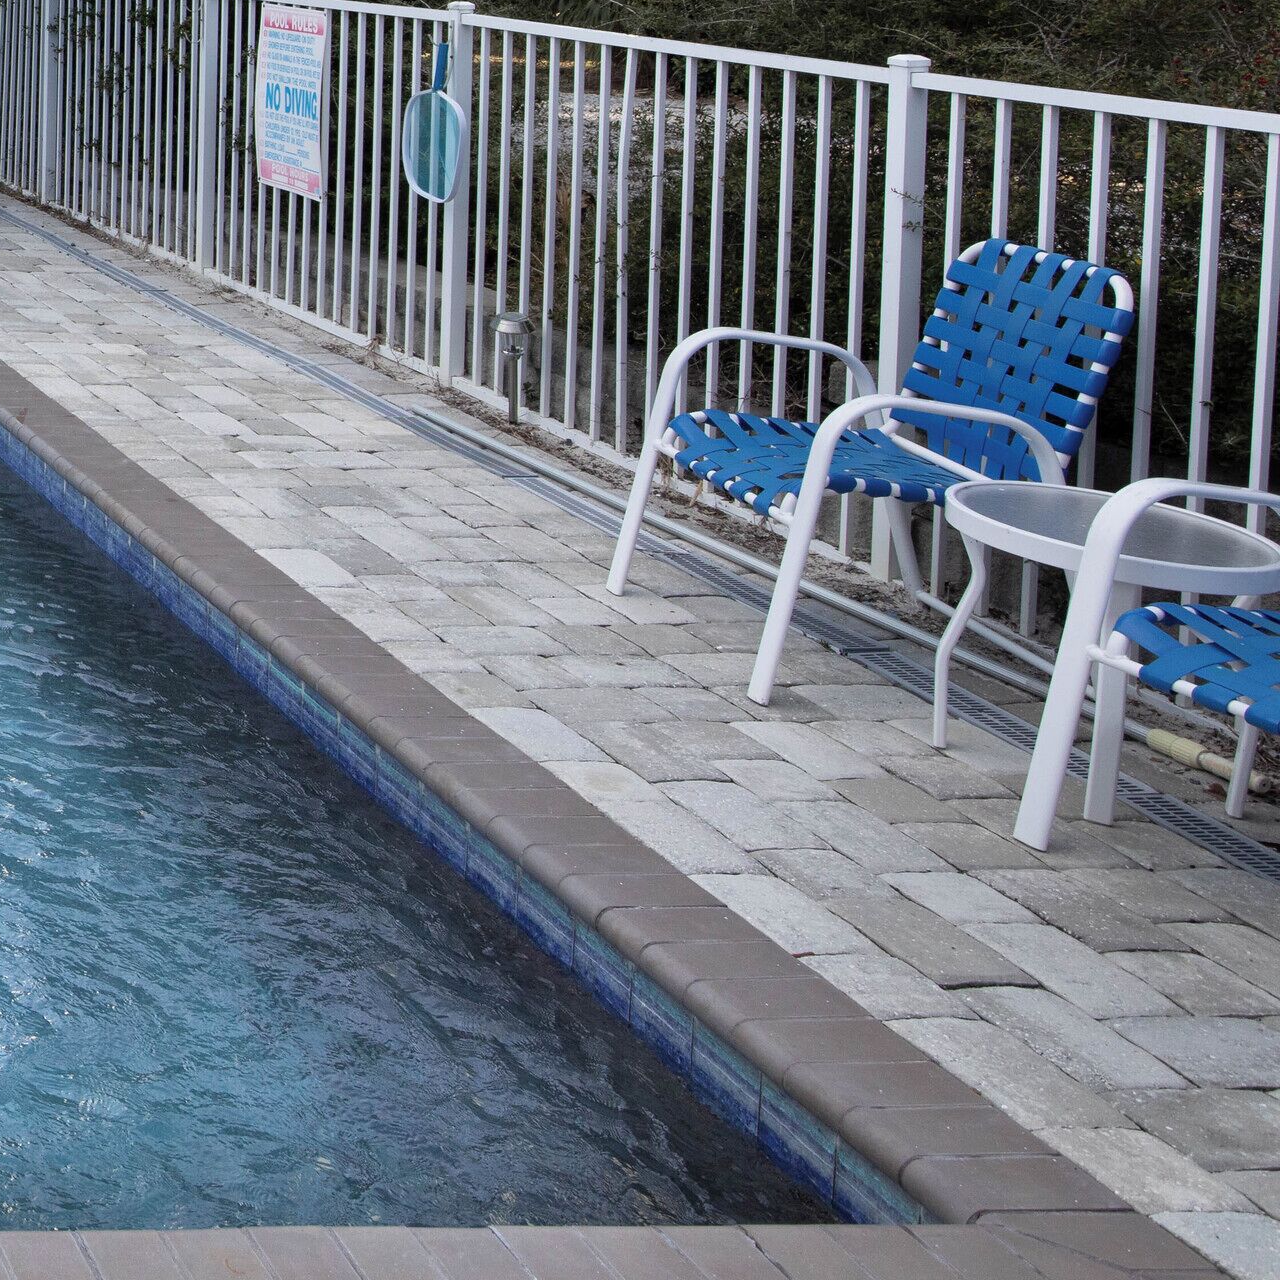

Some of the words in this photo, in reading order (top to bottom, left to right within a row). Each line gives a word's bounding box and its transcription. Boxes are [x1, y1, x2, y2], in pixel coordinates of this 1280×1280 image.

[269, 12, 289, 29] POOL
[291, 15, 318, 34] RULES
[265, 82, 280, 111] NO
